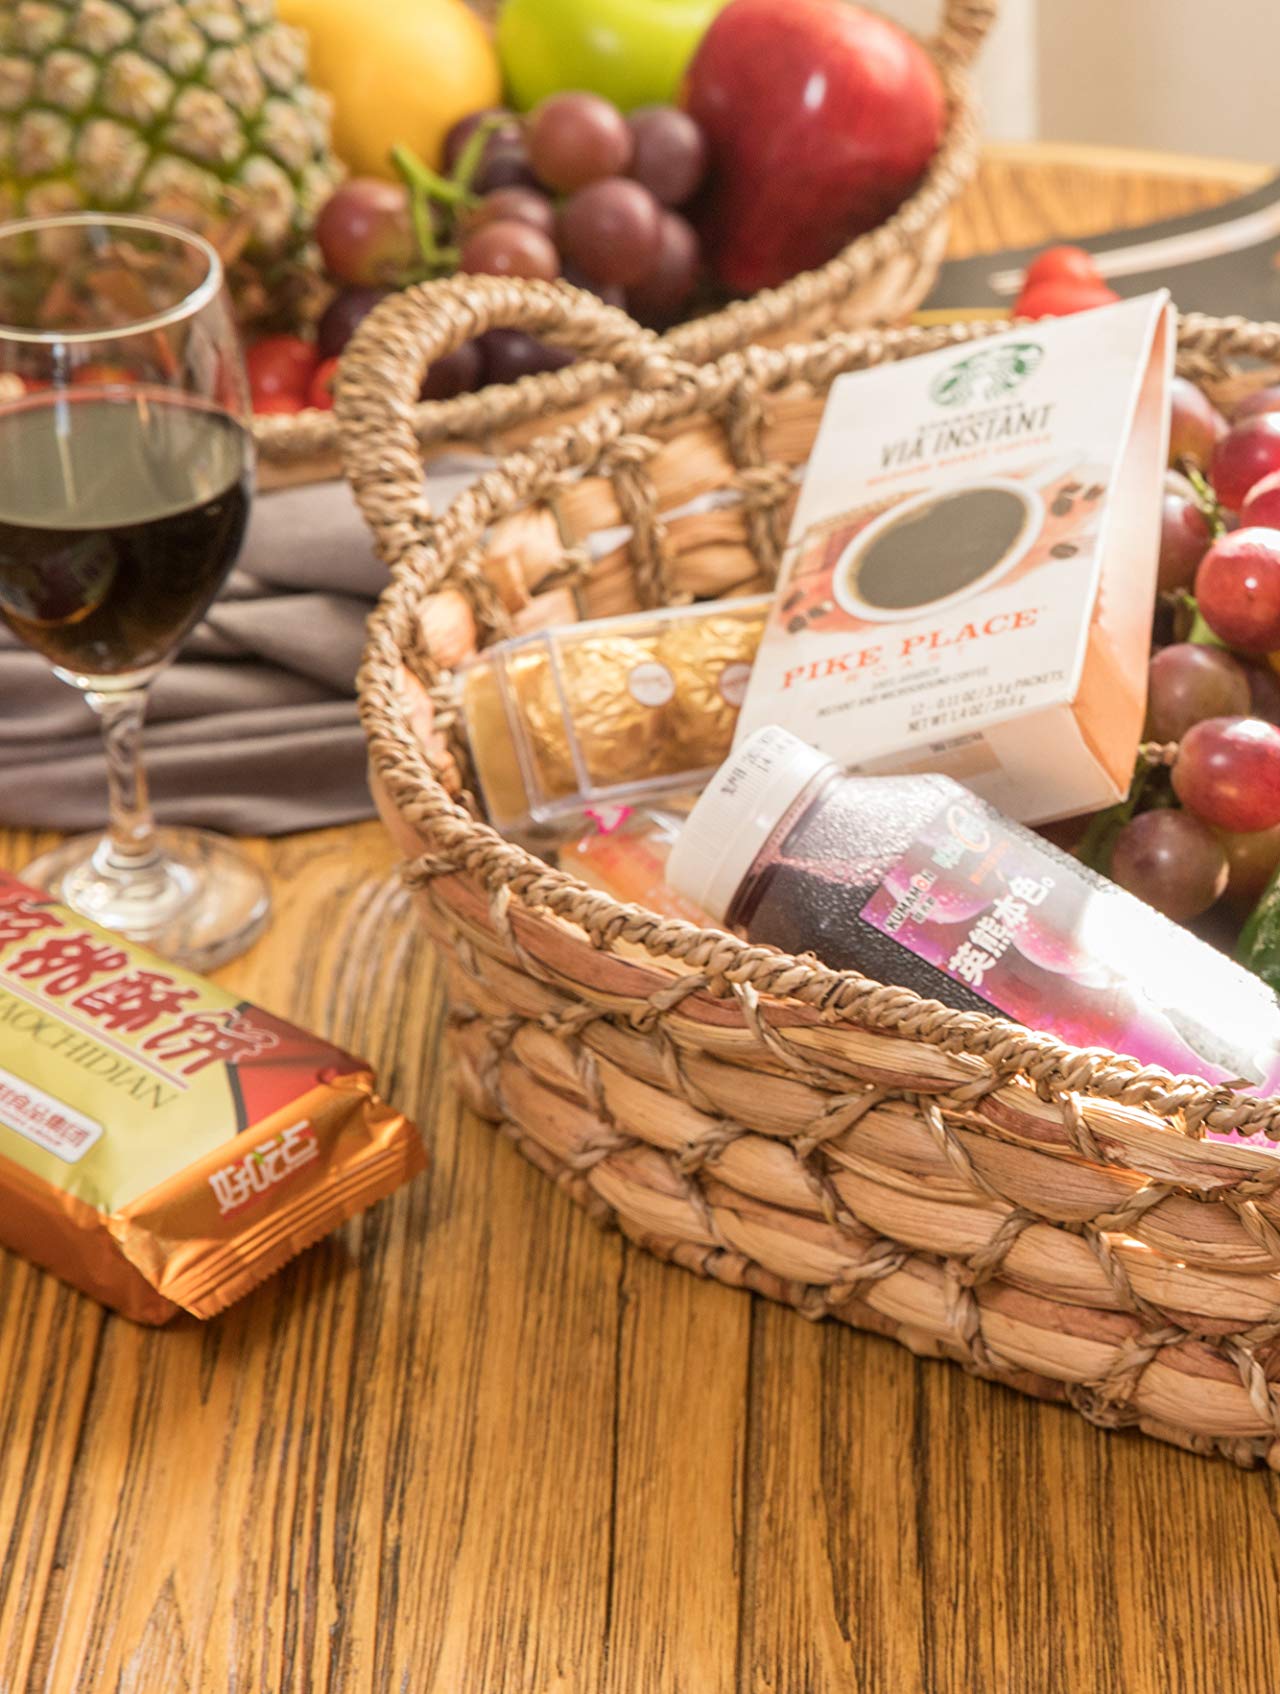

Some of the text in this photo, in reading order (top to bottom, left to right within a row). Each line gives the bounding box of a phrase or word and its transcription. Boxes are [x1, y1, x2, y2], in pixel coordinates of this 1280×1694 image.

[881, 437, 924, 469] VIA
[933, 403, 1055, 454] INSTANT
[781, 608, 1039, 690] PIKE PLACE
[885, 870, 937, 932] KUMAMON
